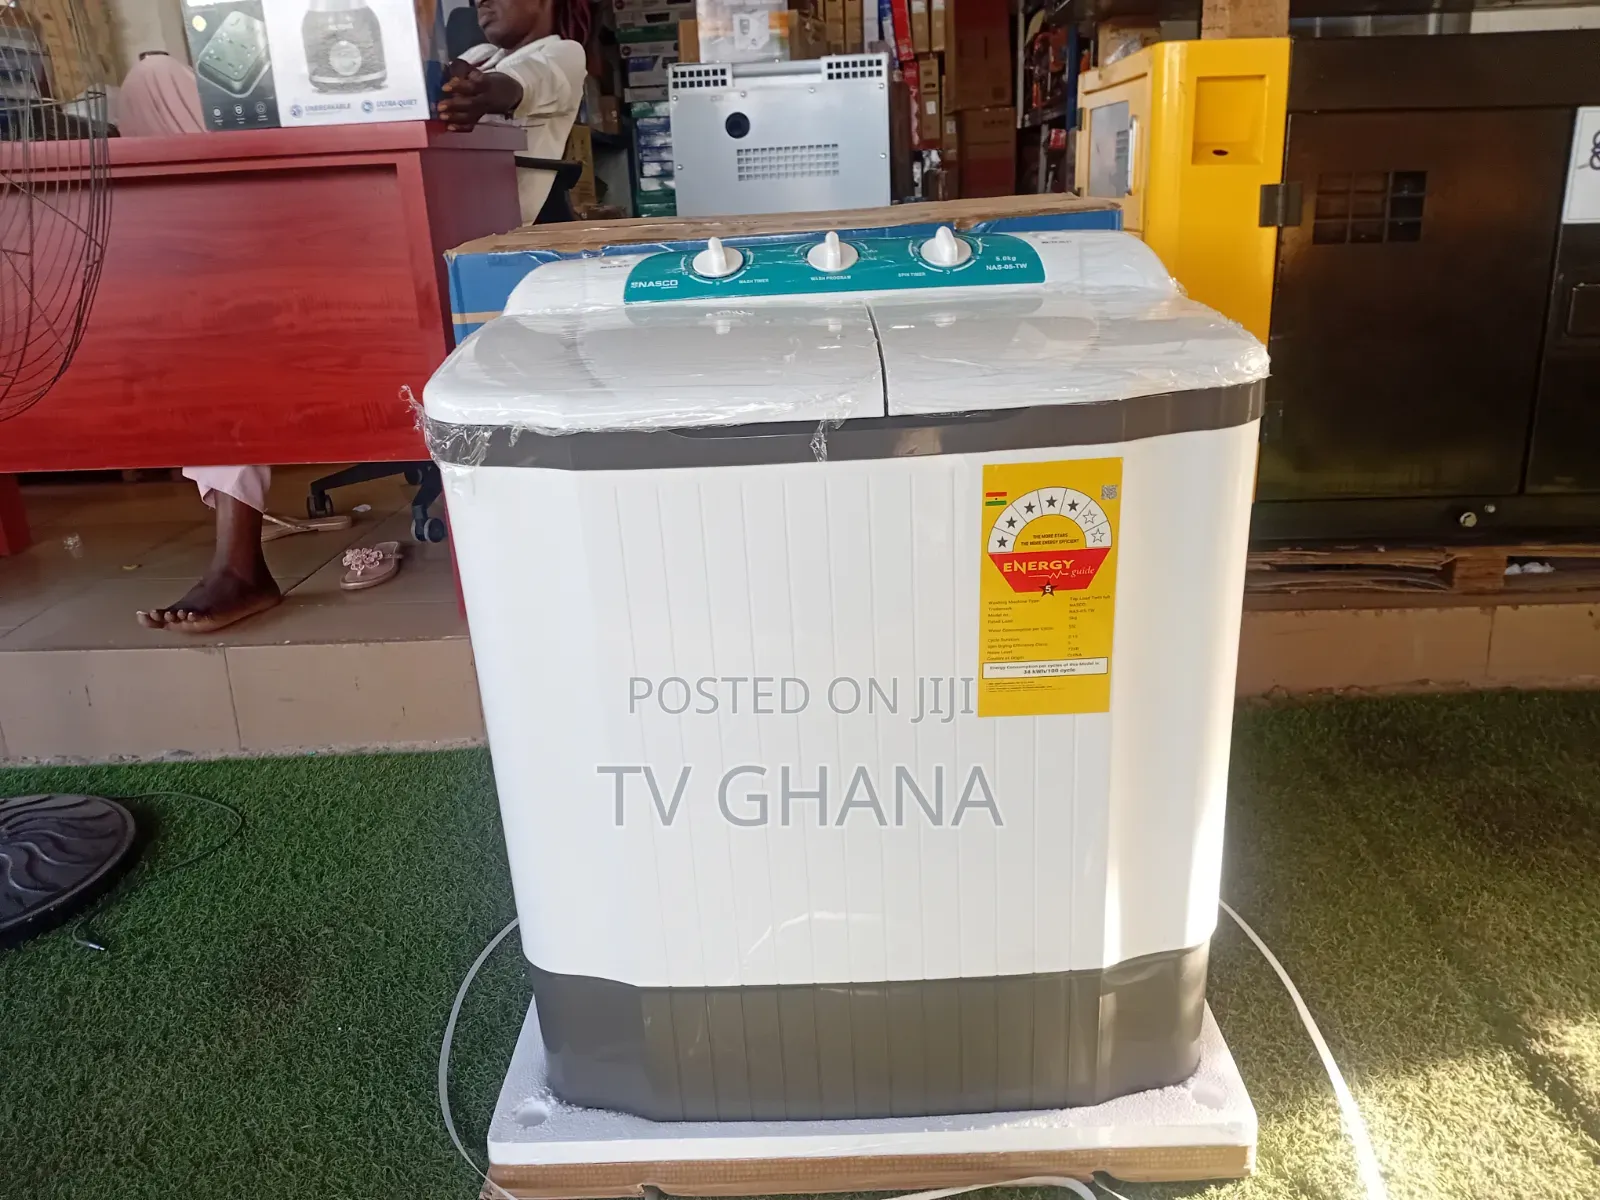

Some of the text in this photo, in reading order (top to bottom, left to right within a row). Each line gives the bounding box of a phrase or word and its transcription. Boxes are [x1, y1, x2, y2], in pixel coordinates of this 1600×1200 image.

[986, 263, 1028, 271] NAS-05-TW
[637, 279, 679, 288] NASCO
[1003, 559, 1075, 575] ENERGY
[1070, 566, 1095, 578] guide
